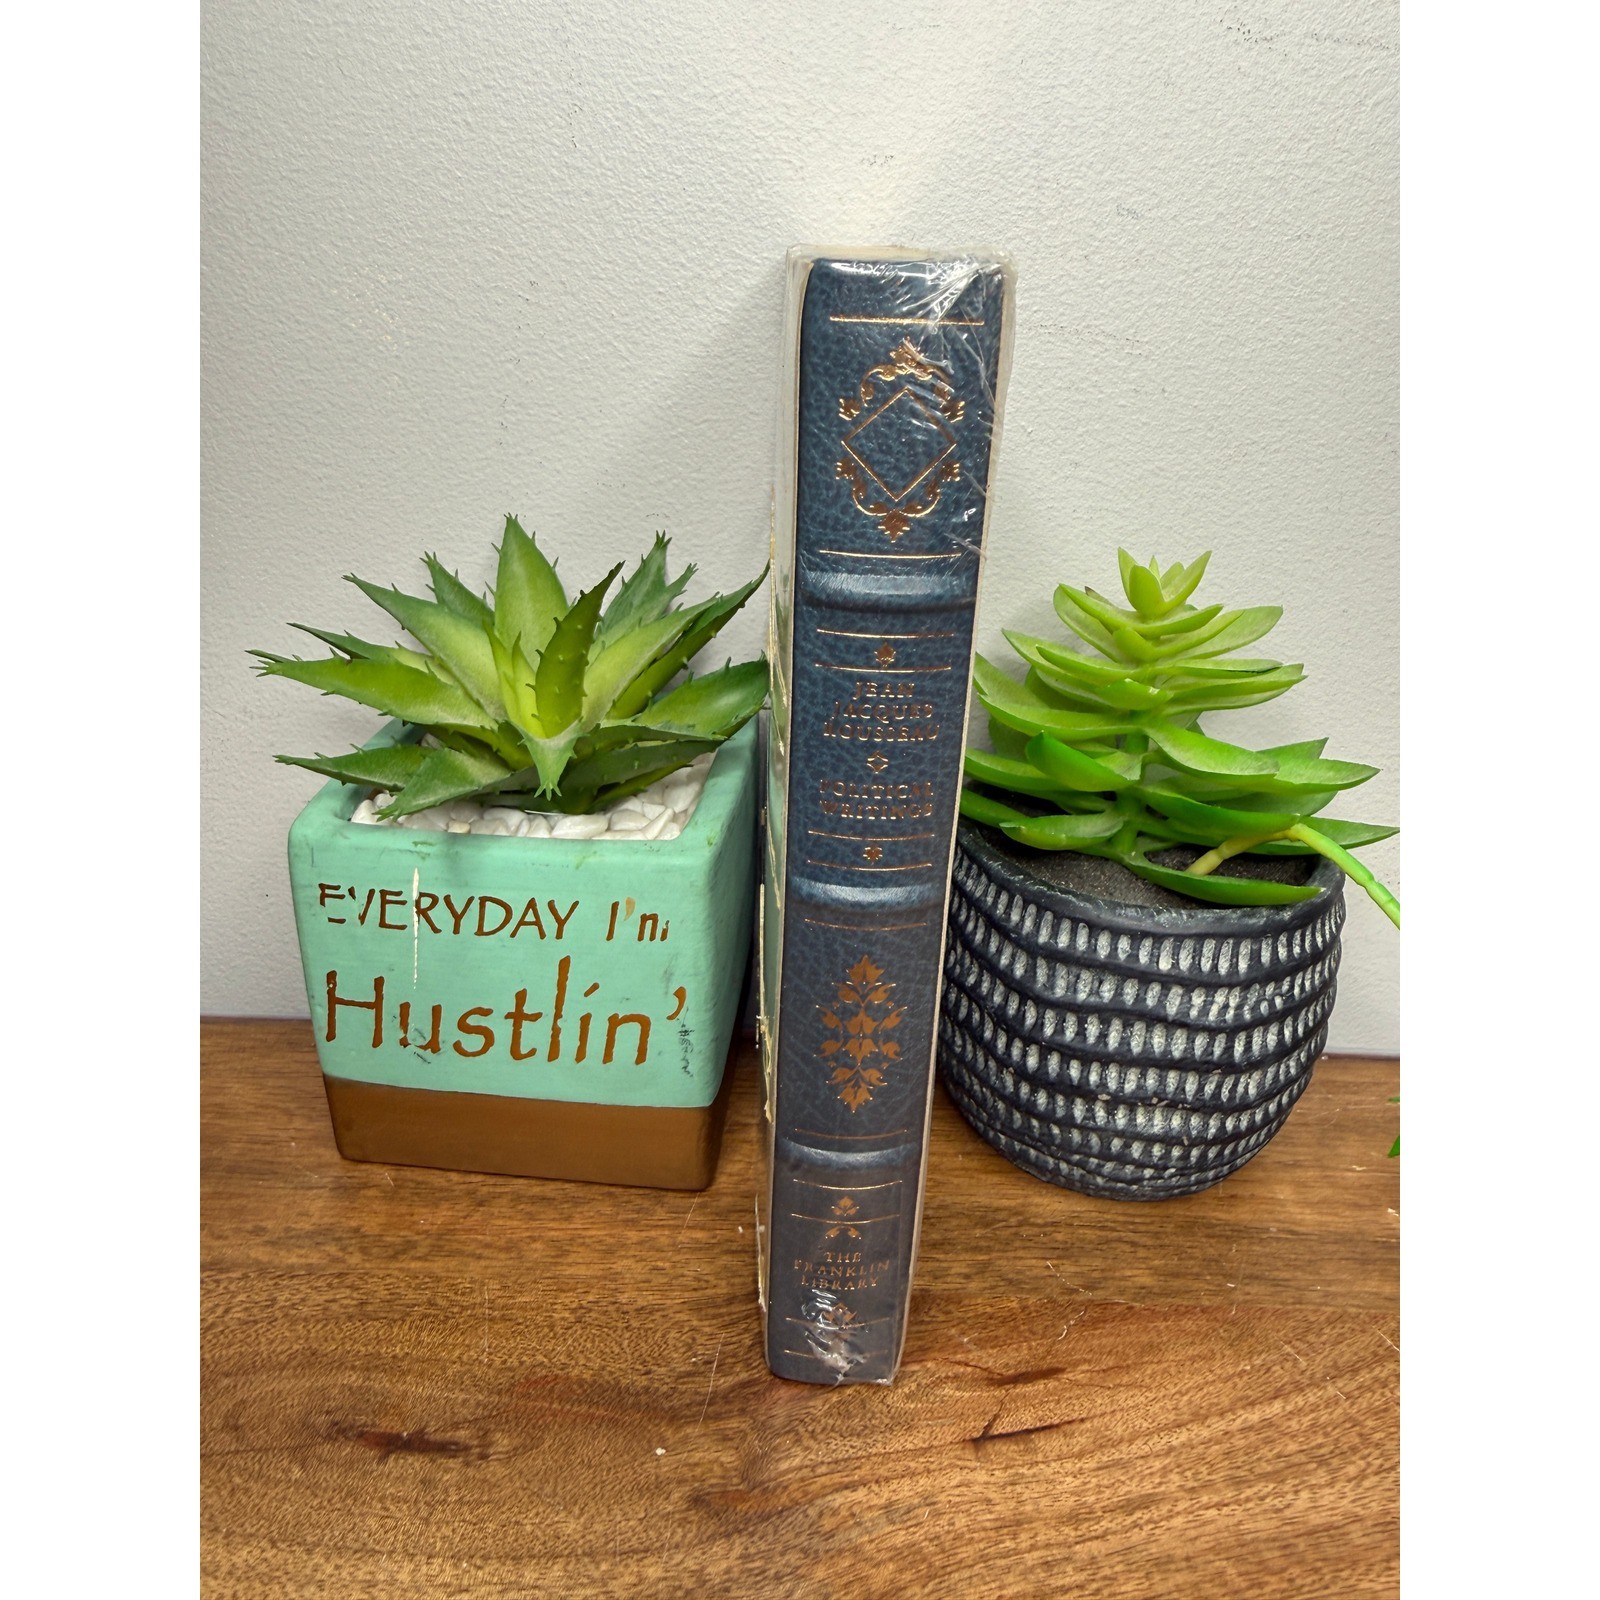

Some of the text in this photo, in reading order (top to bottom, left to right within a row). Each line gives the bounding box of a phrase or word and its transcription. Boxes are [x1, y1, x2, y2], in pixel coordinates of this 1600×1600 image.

[852, 681, 915, 700] JEAN
[830, 700, 934, 724] JACQUES
[818, 778, 935, 799] POLITICAL
[818, 800, 934, 820] WRITINGS
[318, 882, 580, 940] EVERYDAY
[823, 1251, 862, 1263] THE
[793, 1259, 890, 1277] FRANKLIN
[801, 1275, 879, 1290] LIBRARY
